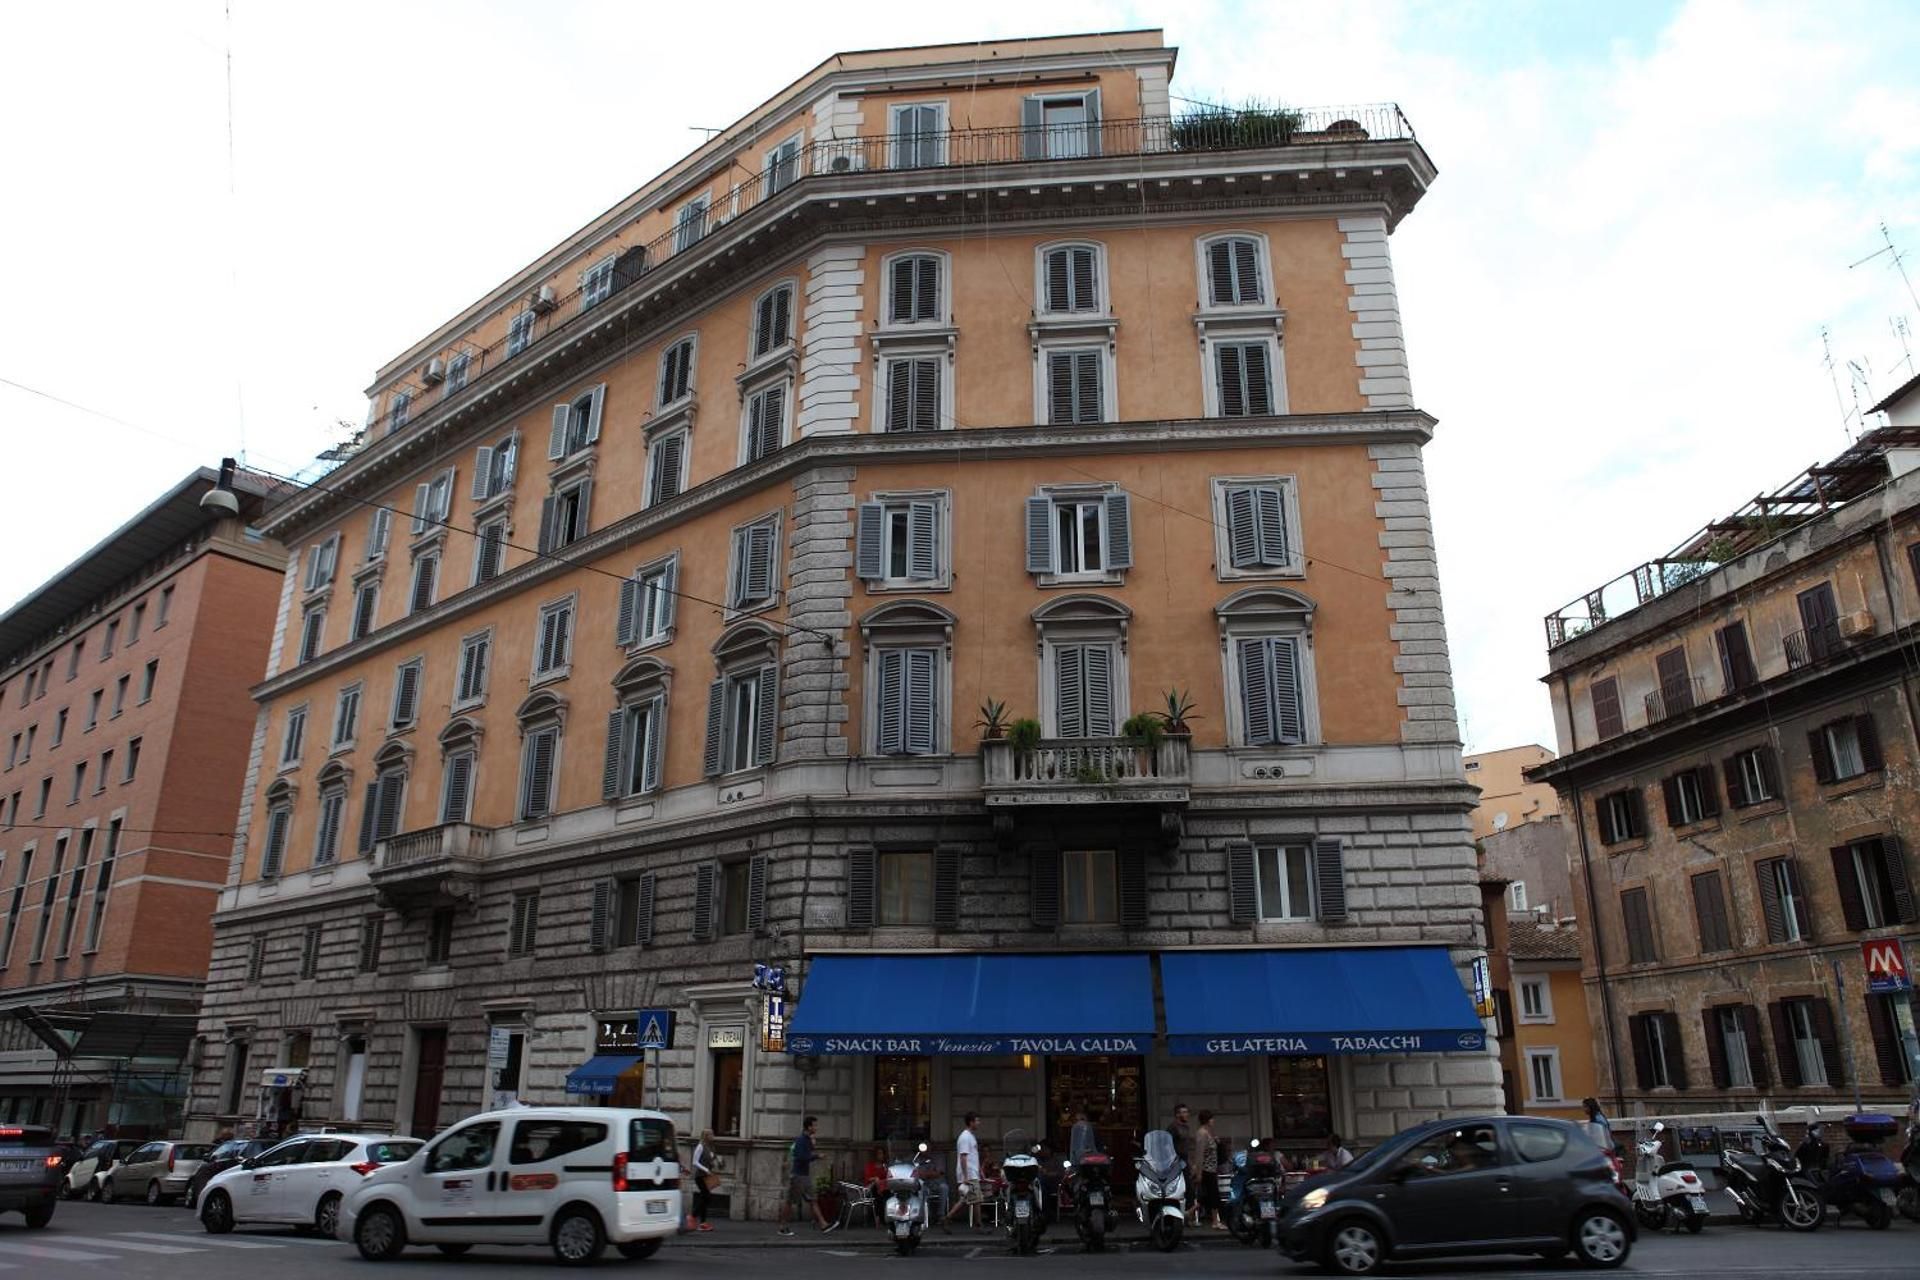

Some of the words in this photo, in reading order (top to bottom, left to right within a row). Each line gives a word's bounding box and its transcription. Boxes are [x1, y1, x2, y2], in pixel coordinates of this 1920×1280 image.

[1869, 946, 1903, 972] M
[825, 1039, 882, 1052] SNACK
[886, 1039, 921, 1052] BAR
[1009, 1039, 1076, 1052] TAVOLA
[1081, 1039, 1137, 1052] CALDA
[1206, 1038, 1308, 1053] GELATERIA
[1331, 1036, 1421, 1050] TABACCHI
